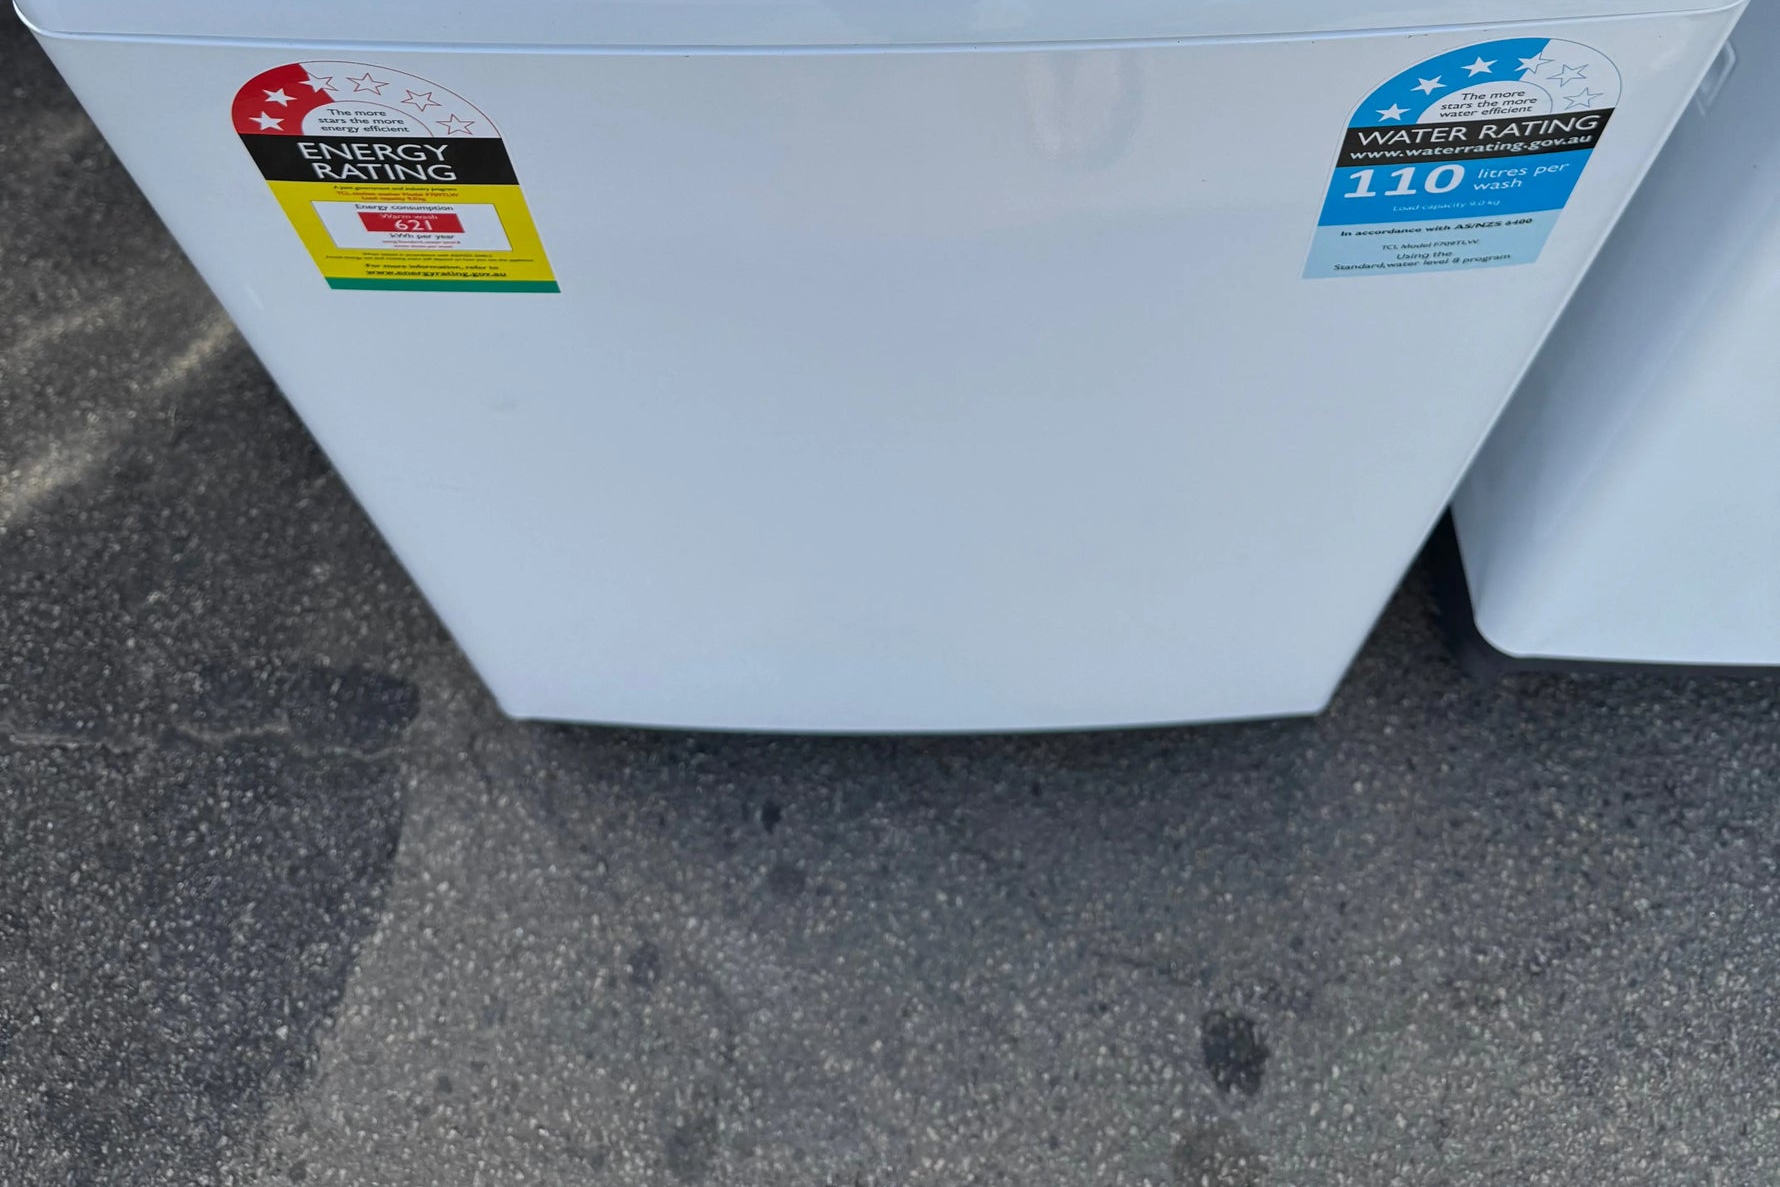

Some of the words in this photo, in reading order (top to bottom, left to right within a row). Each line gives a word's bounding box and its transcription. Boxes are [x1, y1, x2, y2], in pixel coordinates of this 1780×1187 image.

[1462, 92, 1486, 102] The
[1488, 90, 1526, 100] more
[1440, 102, 1474, 111] stars
[1477, 99, 1500, 109] the
[1502, 97, 1538, 106] more
[327, 108, 352, 116] The
[1439, 108, 1479, 118] water
[1481, 105, 1533, 116] efficient
[350, 117, 370, 125] the
[321, 126, 360, 134] energy
[363, 125, 410, 133] efficient
[1357, 126, 1467, 147] WATER
[1478, 114, 1603, 140] RATING
[297, 142, 449, 162] ENERGY
[1349, 134, 1594, 160] www.waterrating.gov.au
[312, 162, 458, 181] RATING
[1478, 166, 1528, 180] litres
[1532, 162, 1570, 176] per
[1344, 163, 1466, 199] 110
[1473, 178, 1523, 191] wash
[391, 204, 454, 212] consumption
[1422, 202, 1466, 212] capacity
[394, 220, 433, 230] 621
[1355, 228, 1422, 236] accordance
[1454, 220, 1503, 230] AS/NZS
[1504, 218, 1534, 226] 6400
[1400, 242, 1432, 250] Model
[1396, 252, 1430, 260] Using
[1433, 250, 1453, 258] the
[1422, 258, 1449, 266] level
[1462, 254, 1512, 264] program
